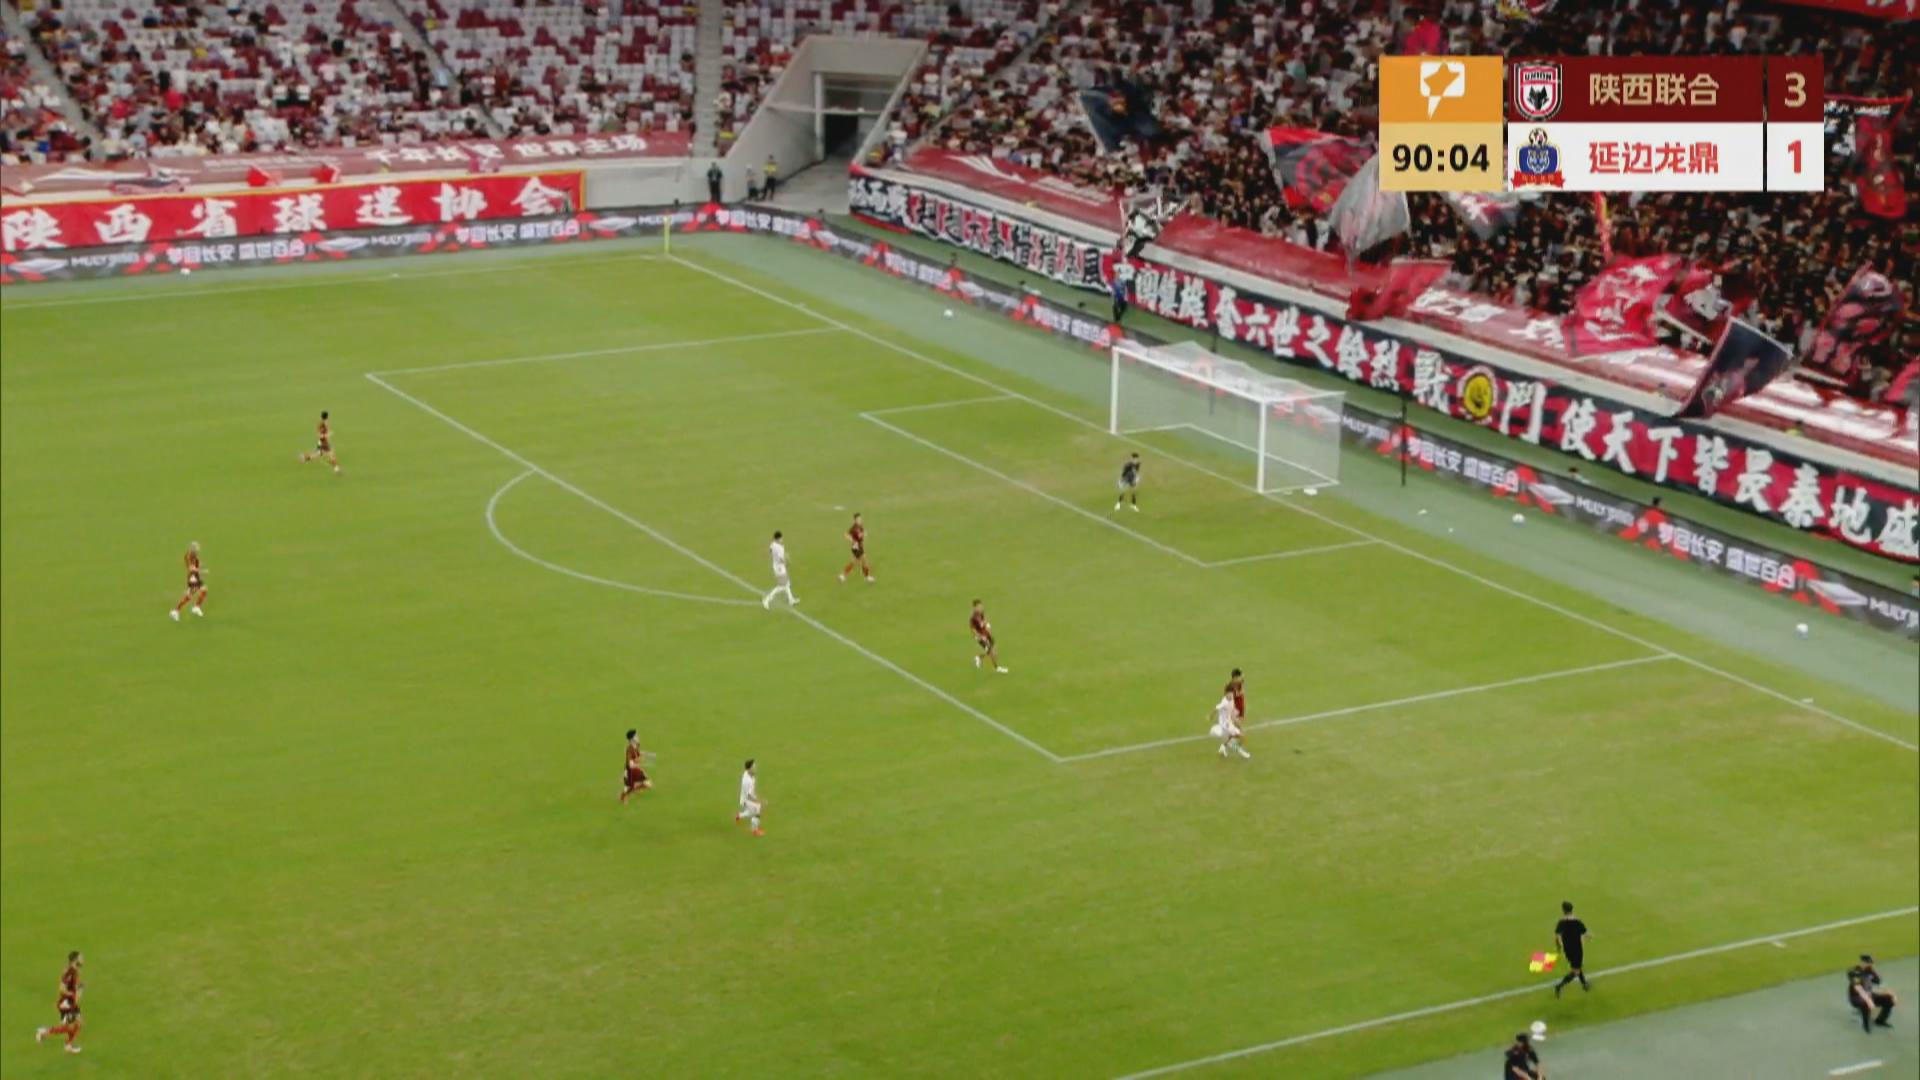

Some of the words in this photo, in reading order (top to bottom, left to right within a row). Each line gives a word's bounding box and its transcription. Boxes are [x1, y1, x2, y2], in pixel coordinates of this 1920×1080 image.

[512, 134, 648, 157] 世界主场
[1, 176, 573, 251] 陕西省球迷协会
